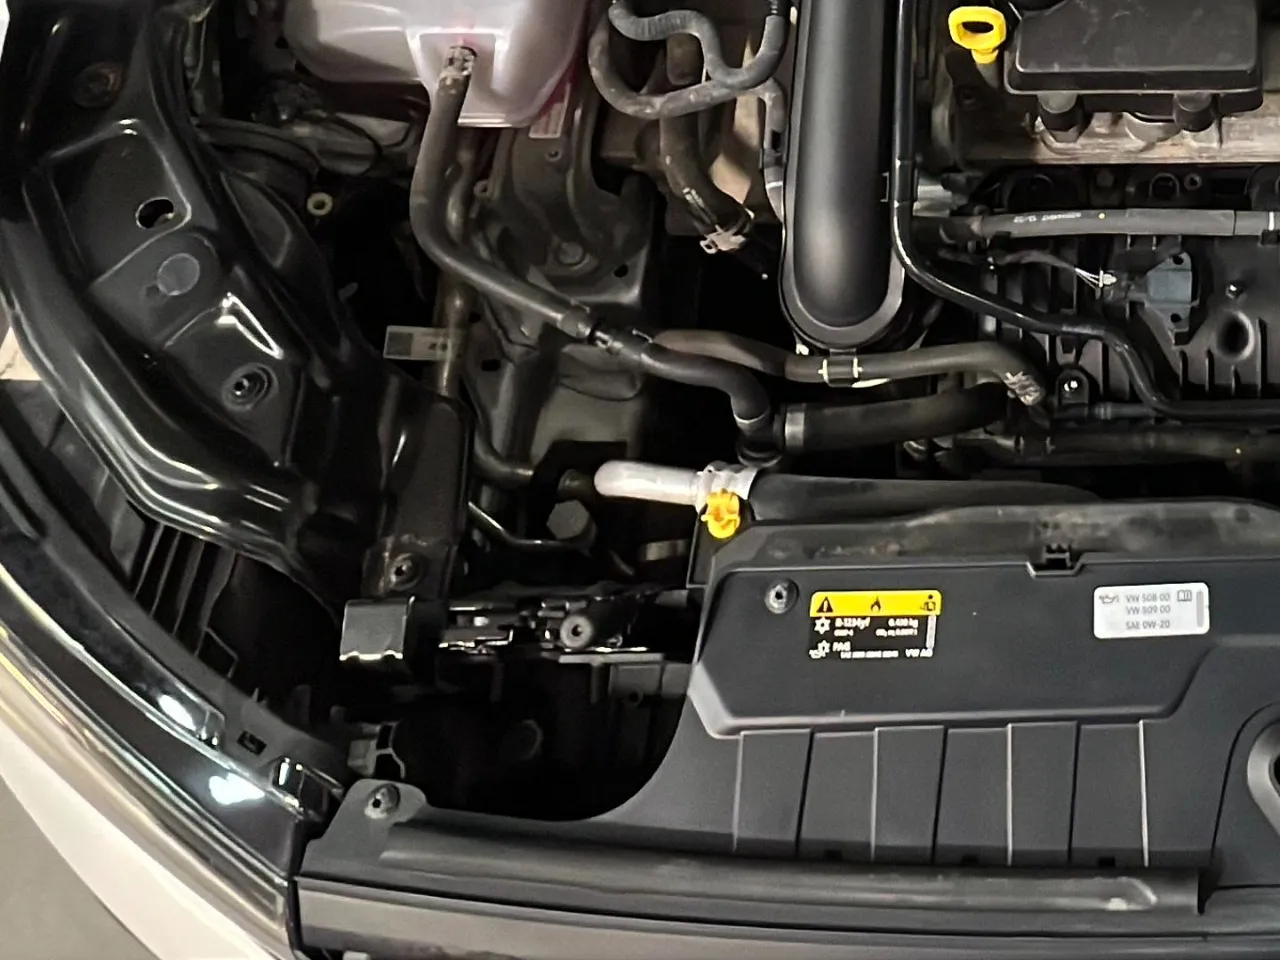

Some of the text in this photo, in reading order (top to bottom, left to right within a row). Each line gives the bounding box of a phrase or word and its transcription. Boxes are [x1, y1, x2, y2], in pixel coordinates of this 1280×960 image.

[1125, 592, 1170, 603] VW 508 00
[1125, 605, 1140, 615] VW
[1159, 604, 1171, 613] 00
[1126, 621, 1140, 630] SAE
